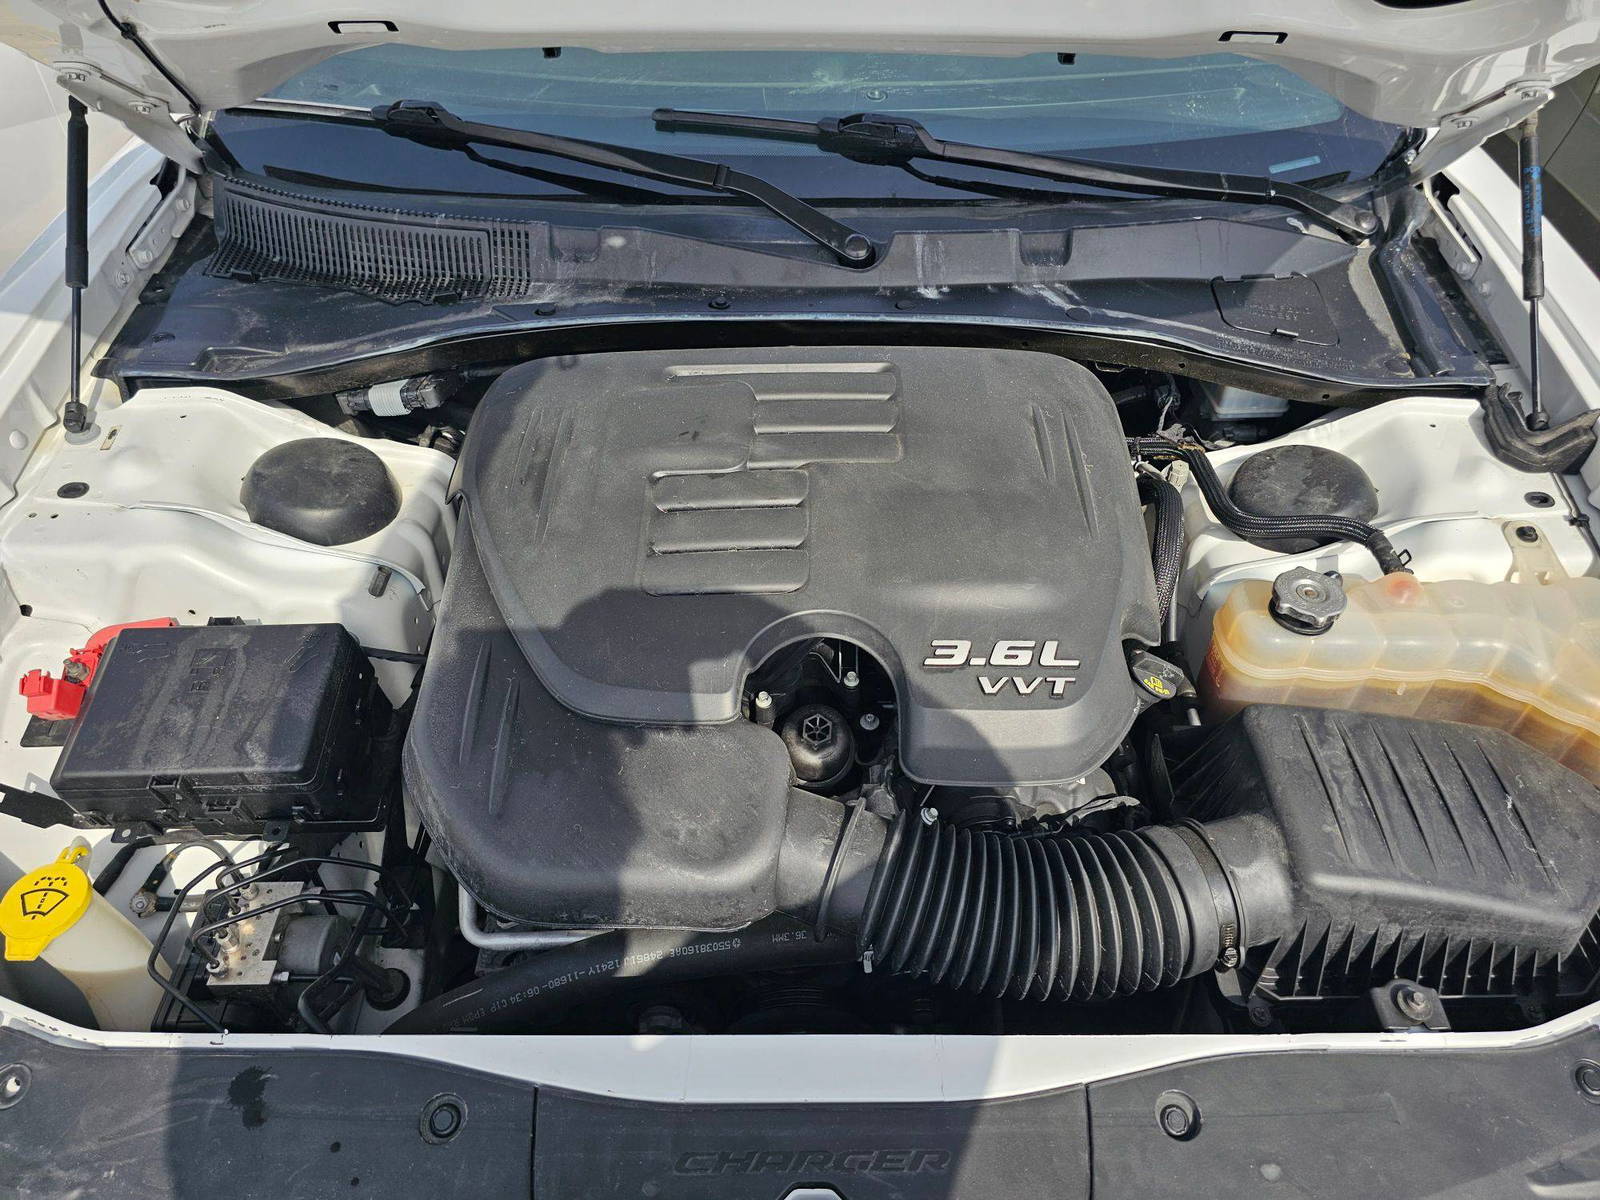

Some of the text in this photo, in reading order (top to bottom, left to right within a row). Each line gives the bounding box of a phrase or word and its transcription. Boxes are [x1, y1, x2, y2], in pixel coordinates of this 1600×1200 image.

[922, 639, 1081, 668] 3.6L
[976, 676, 1077, 697] VVT
[672, 1150, 951, 1176] CHARGER
